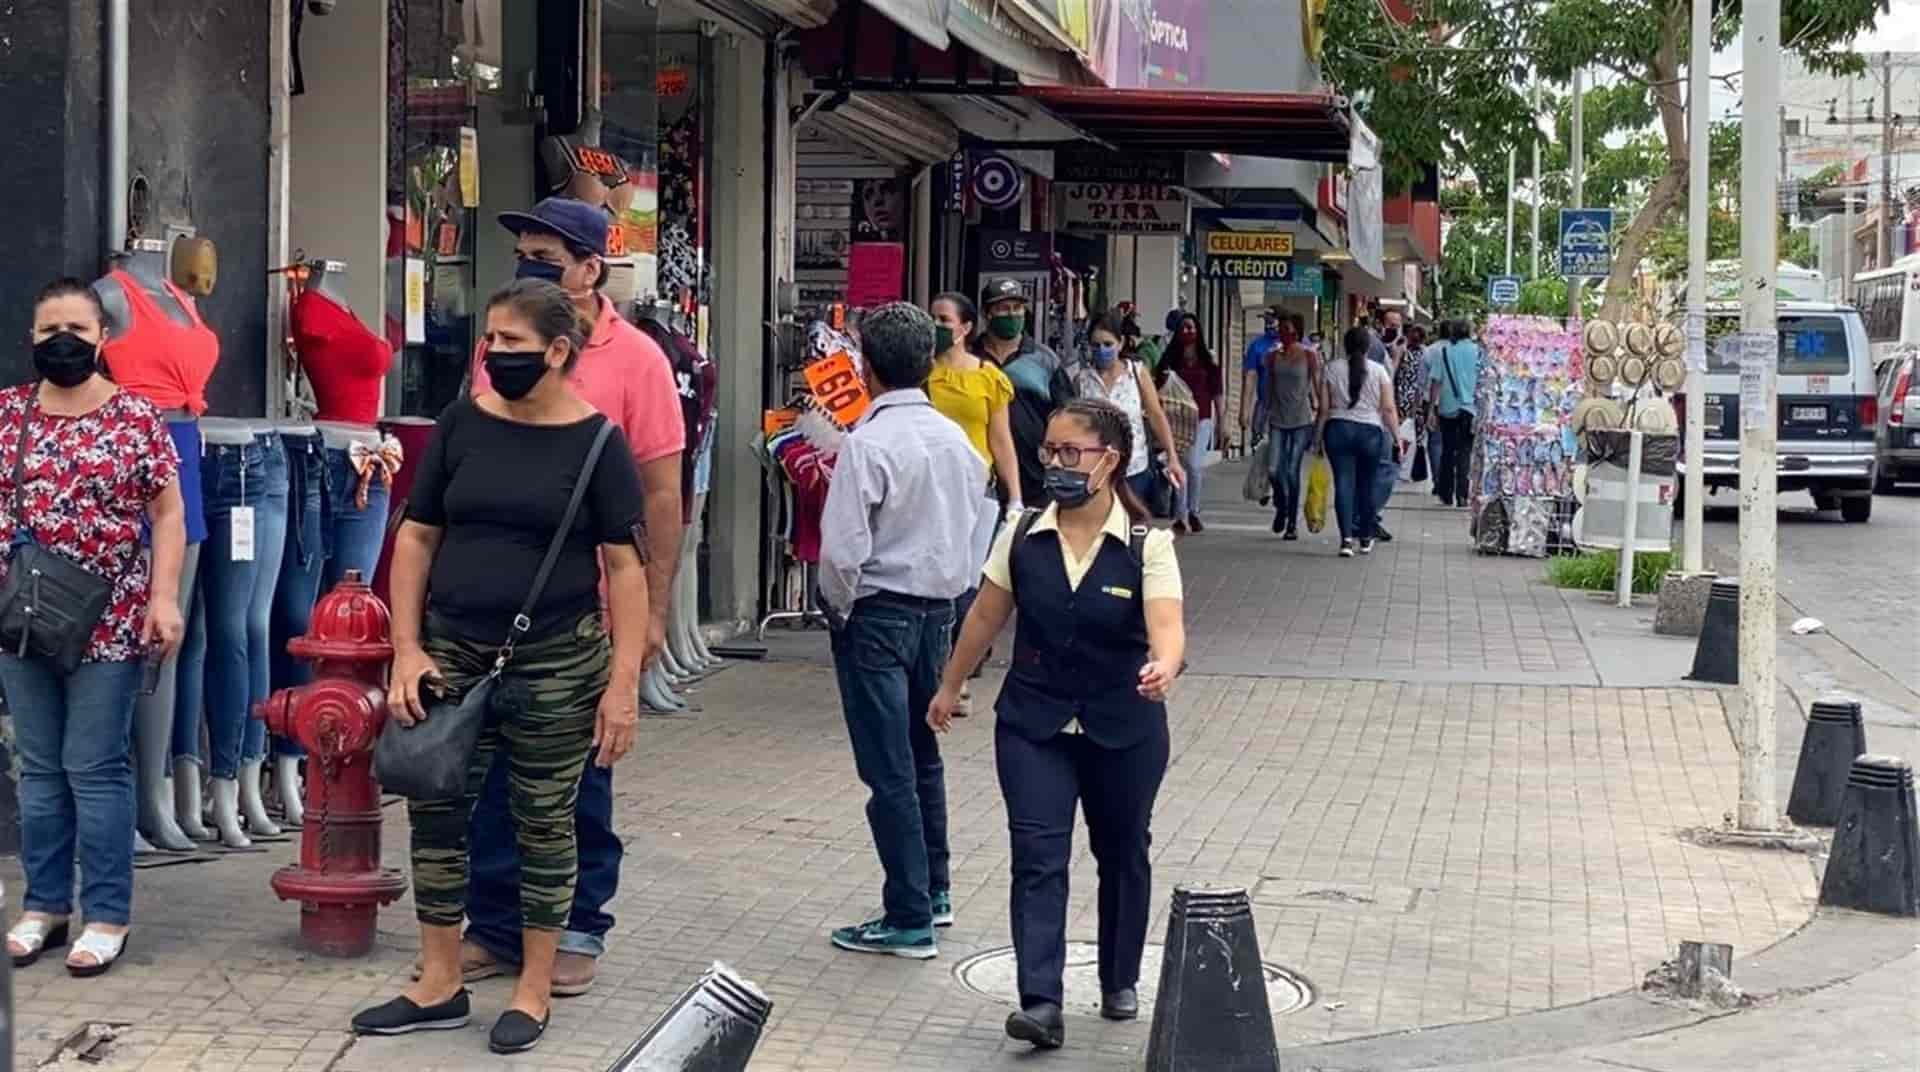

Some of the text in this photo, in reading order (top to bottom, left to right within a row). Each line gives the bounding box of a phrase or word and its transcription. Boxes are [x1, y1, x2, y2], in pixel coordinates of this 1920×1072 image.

[1149, 10, 1189, 52] ÓPTICA
[1211, 234, 1290, 252] CELULARES
[1209, 256, 1288, 278] A CRÉDITO
